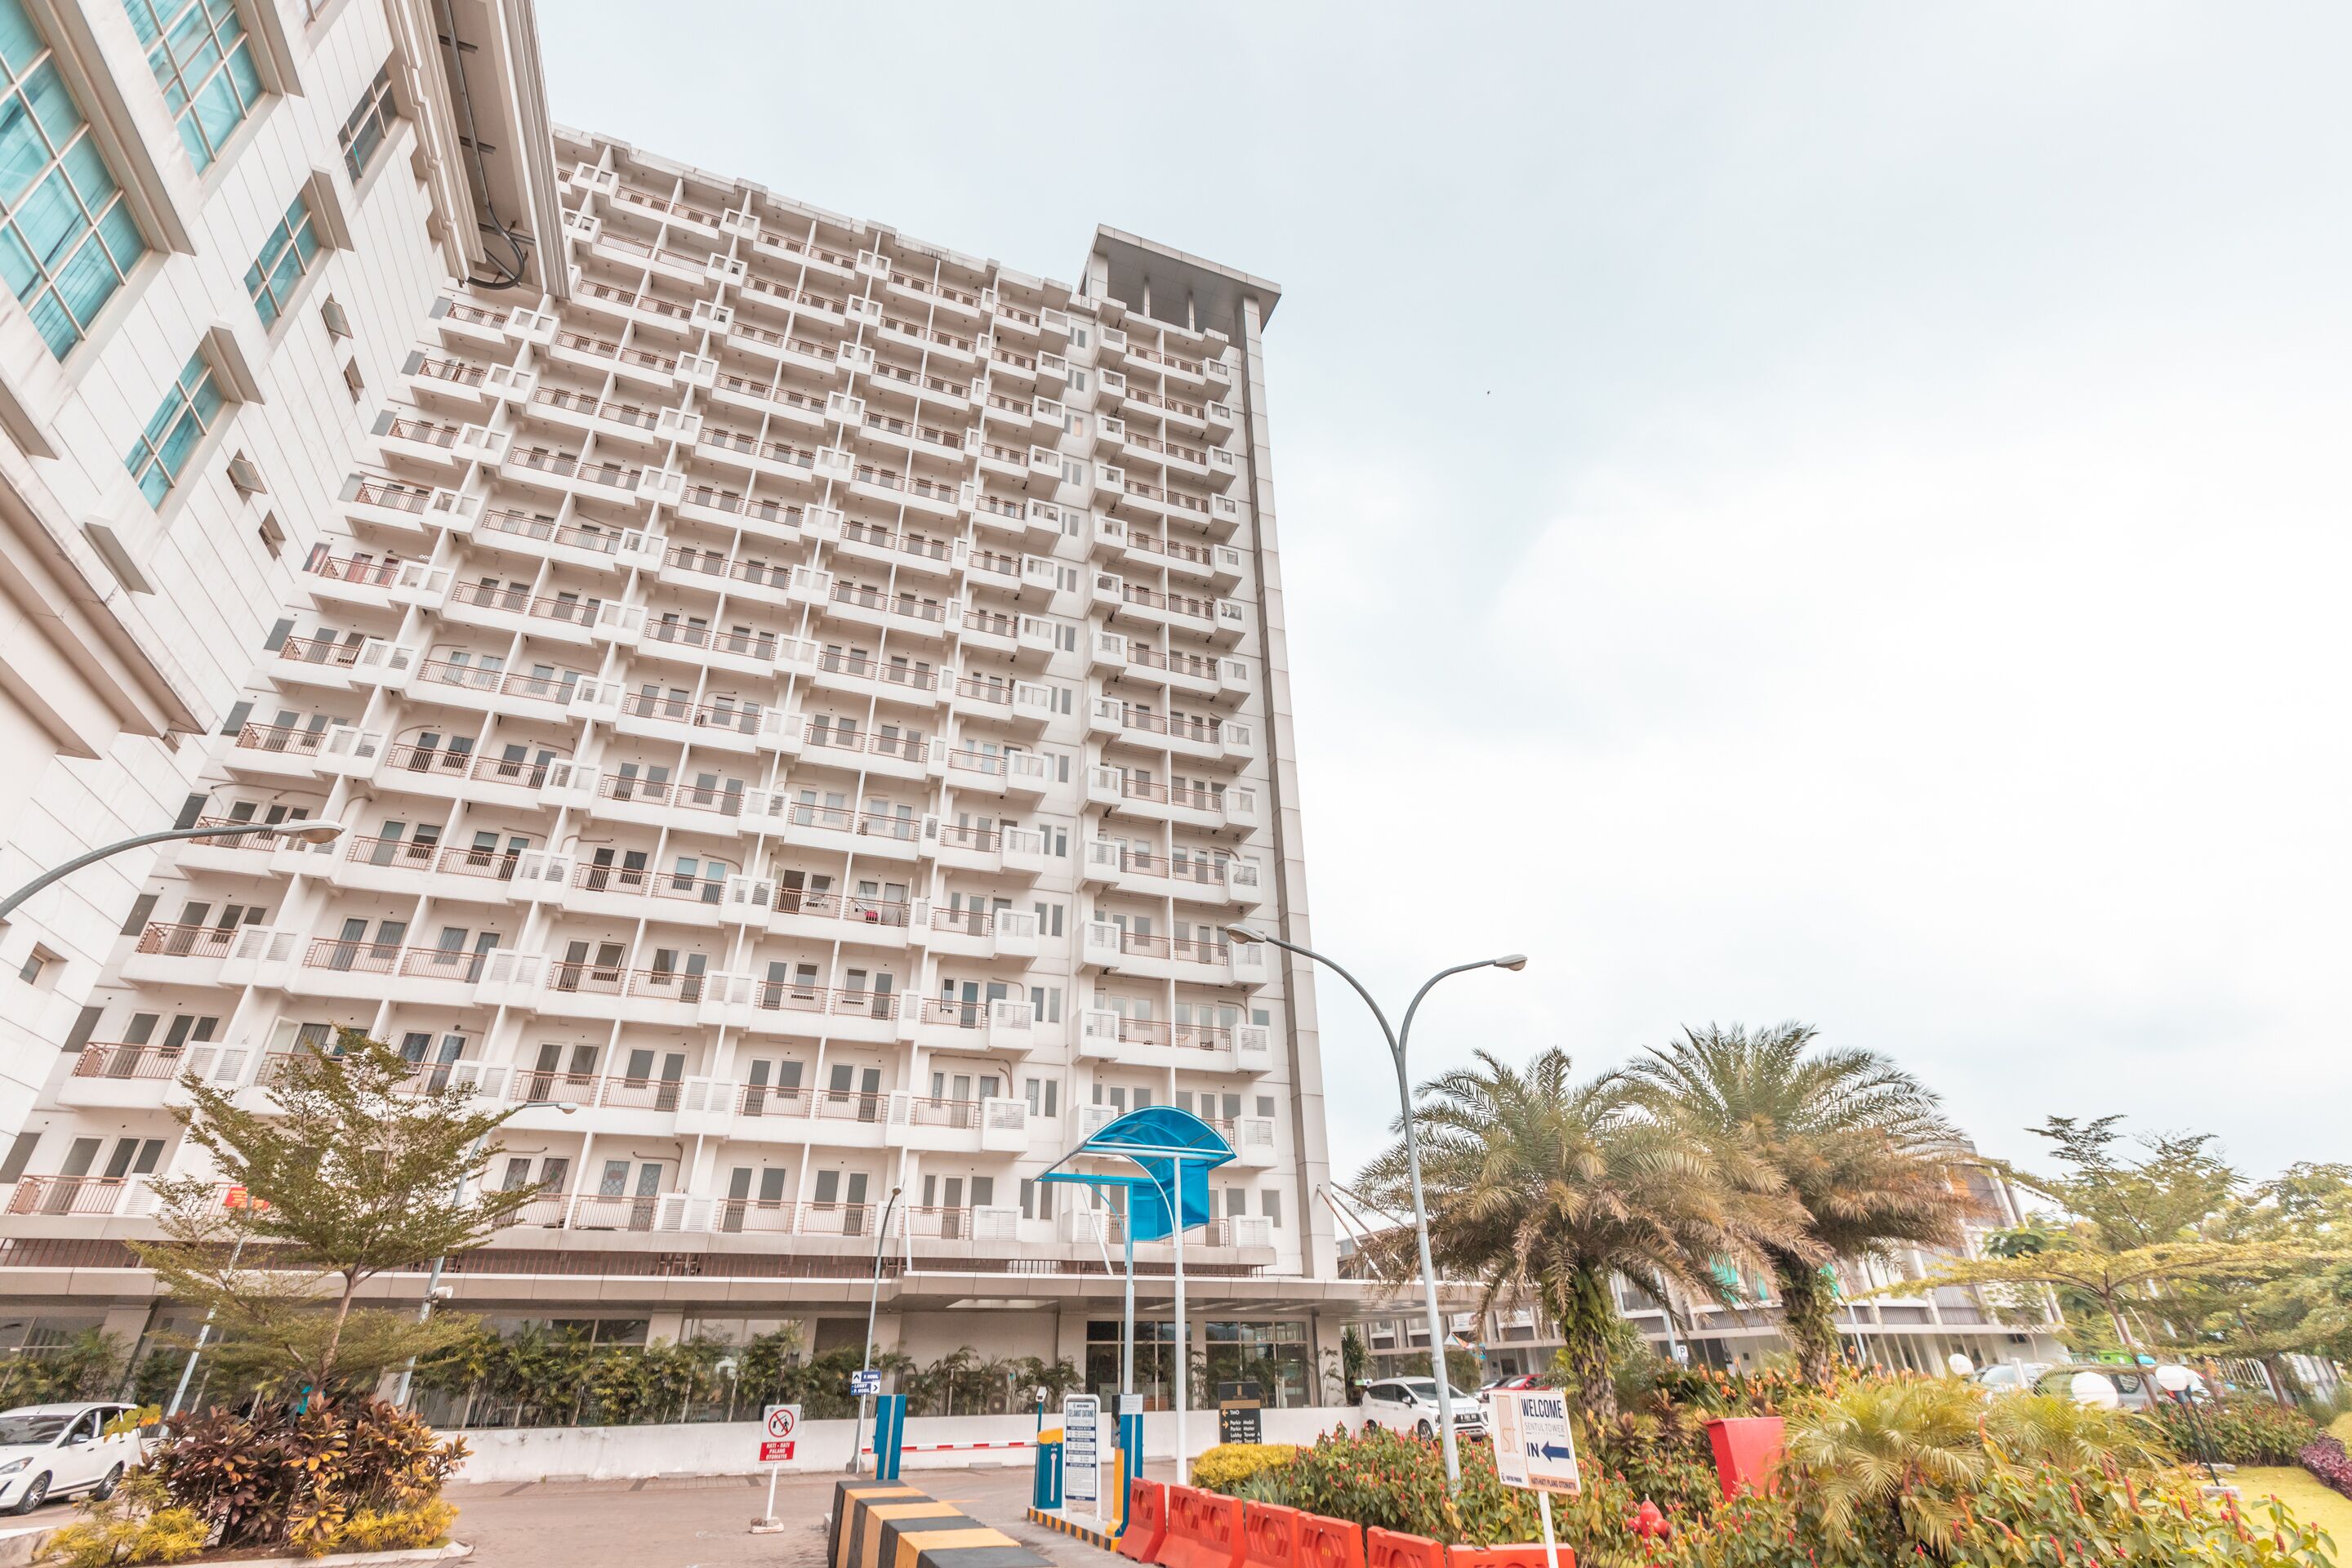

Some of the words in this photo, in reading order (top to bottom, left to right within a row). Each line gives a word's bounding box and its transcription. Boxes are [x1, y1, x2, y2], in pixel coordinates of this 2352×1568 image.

[1680, 1347, 1685, 1356] P
[1082, 1410, 1094, 1418] DATANG
[1521, 1399, 1563, 1419] WELCOME
[1525, 1422, 1544, 1432] SENTUL
[1545, 1423, 1565, 1432] TOWER
[1526, 1442, 1539, 1458] IN
